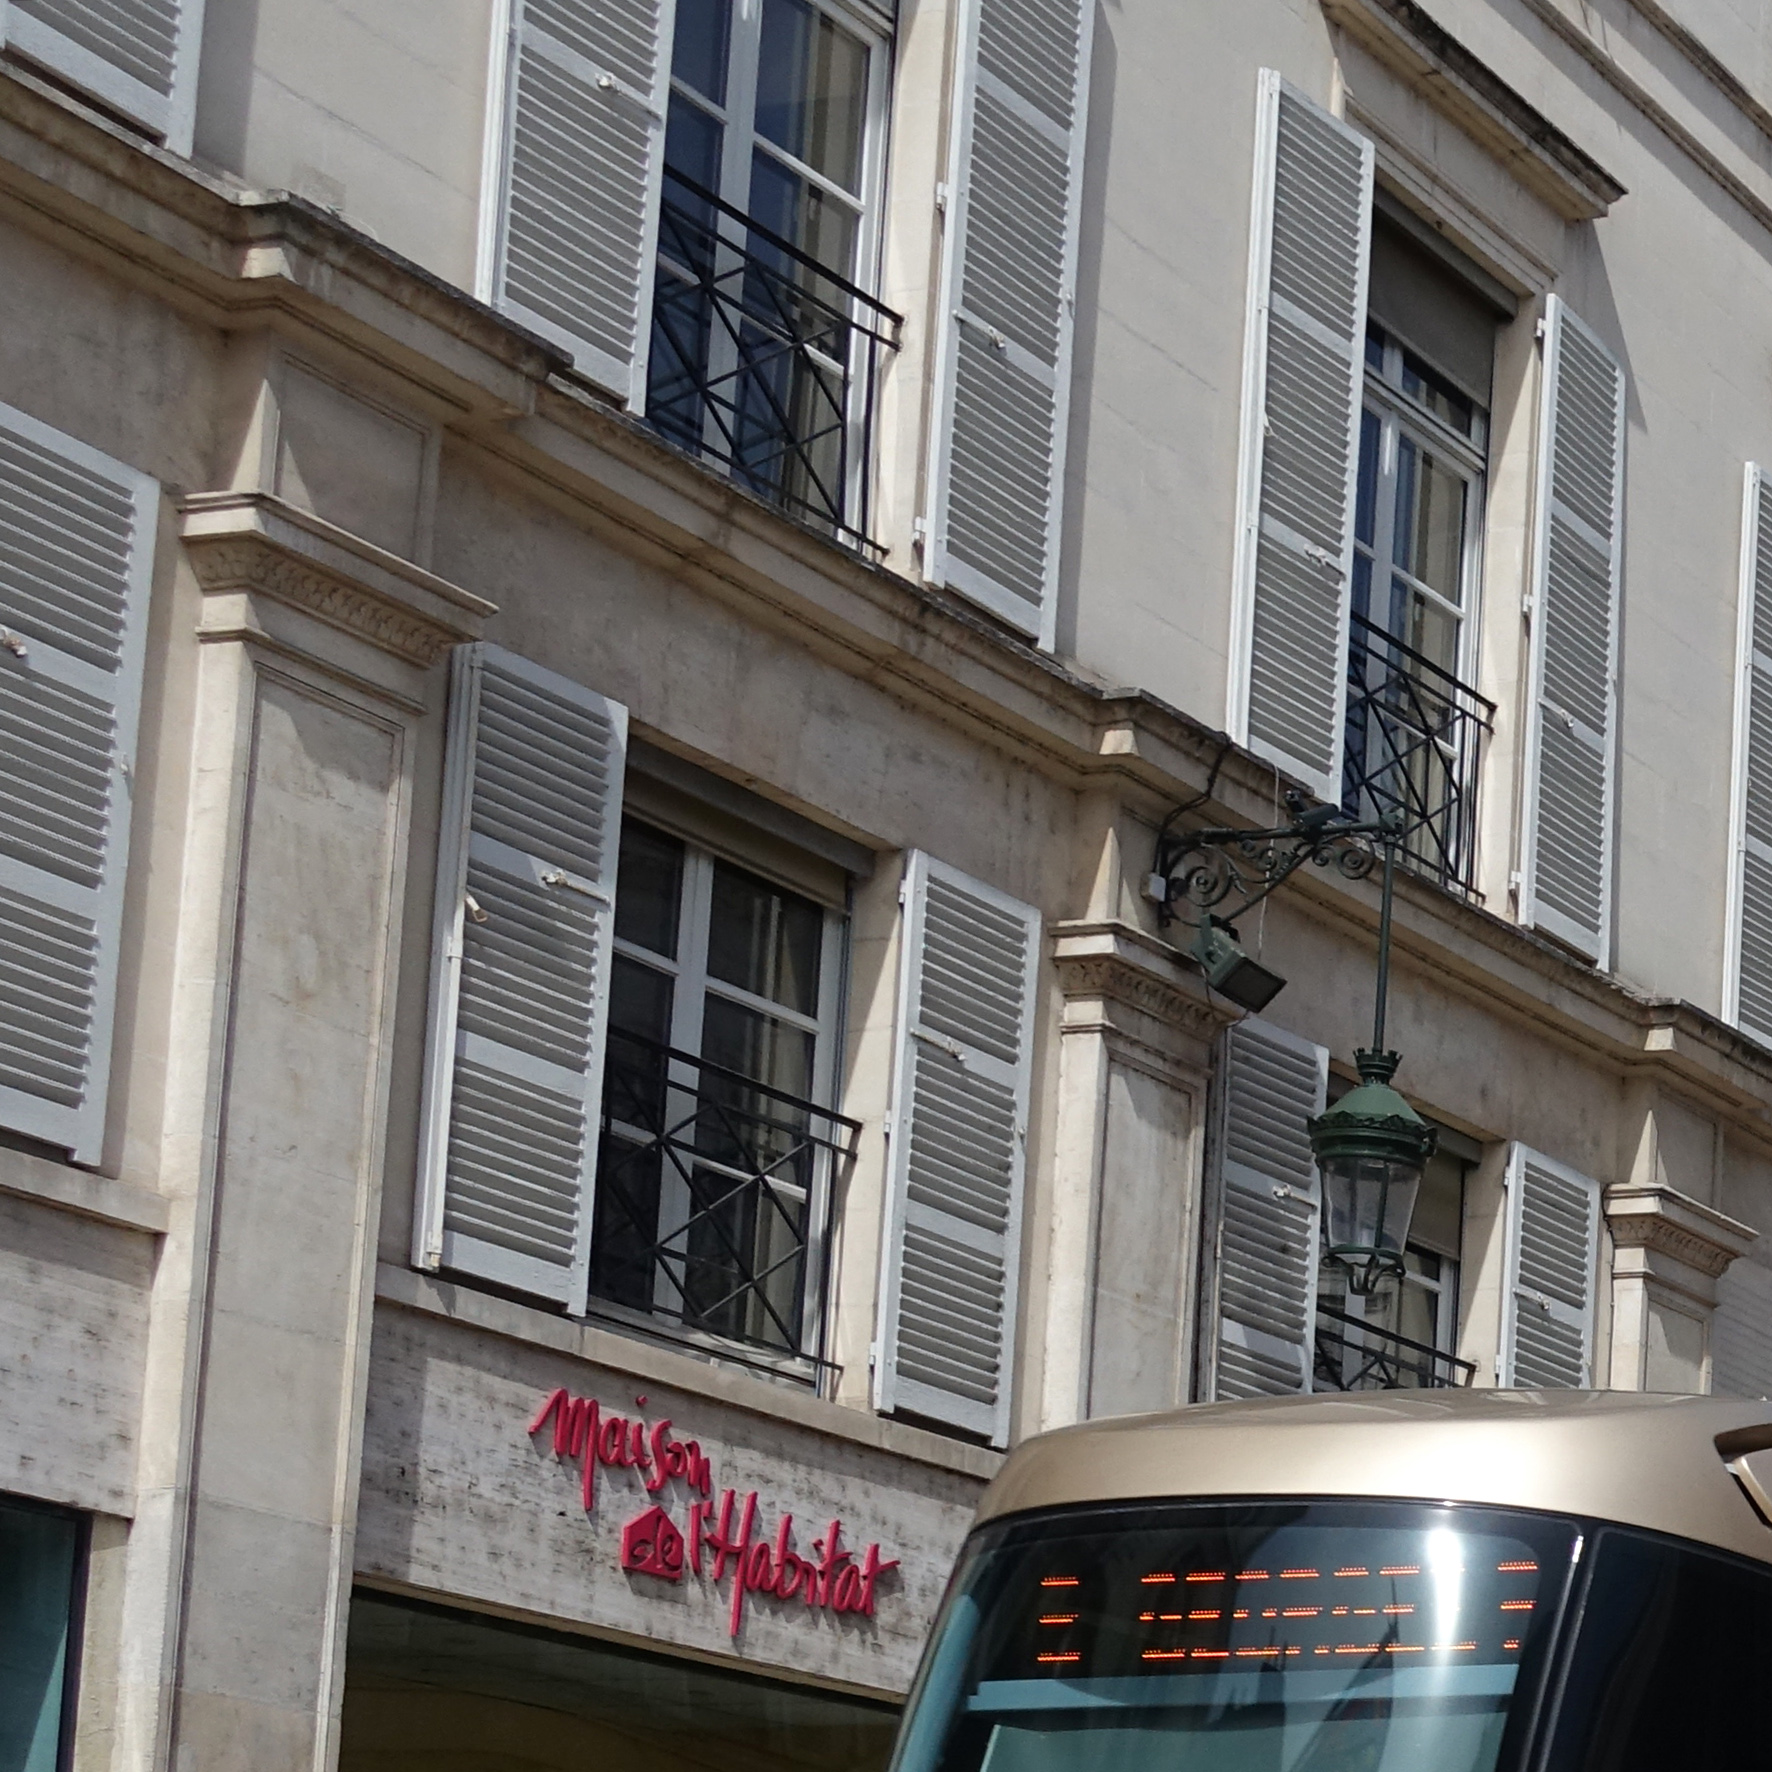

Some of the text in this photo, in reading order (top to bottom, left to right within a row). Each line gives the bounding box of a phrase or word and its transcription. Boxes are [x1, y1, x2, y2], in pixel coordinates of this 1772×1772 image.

[528, 1387, 711, 1512] Maison
[629, 1488, 901, 1637] de l'Habitat
